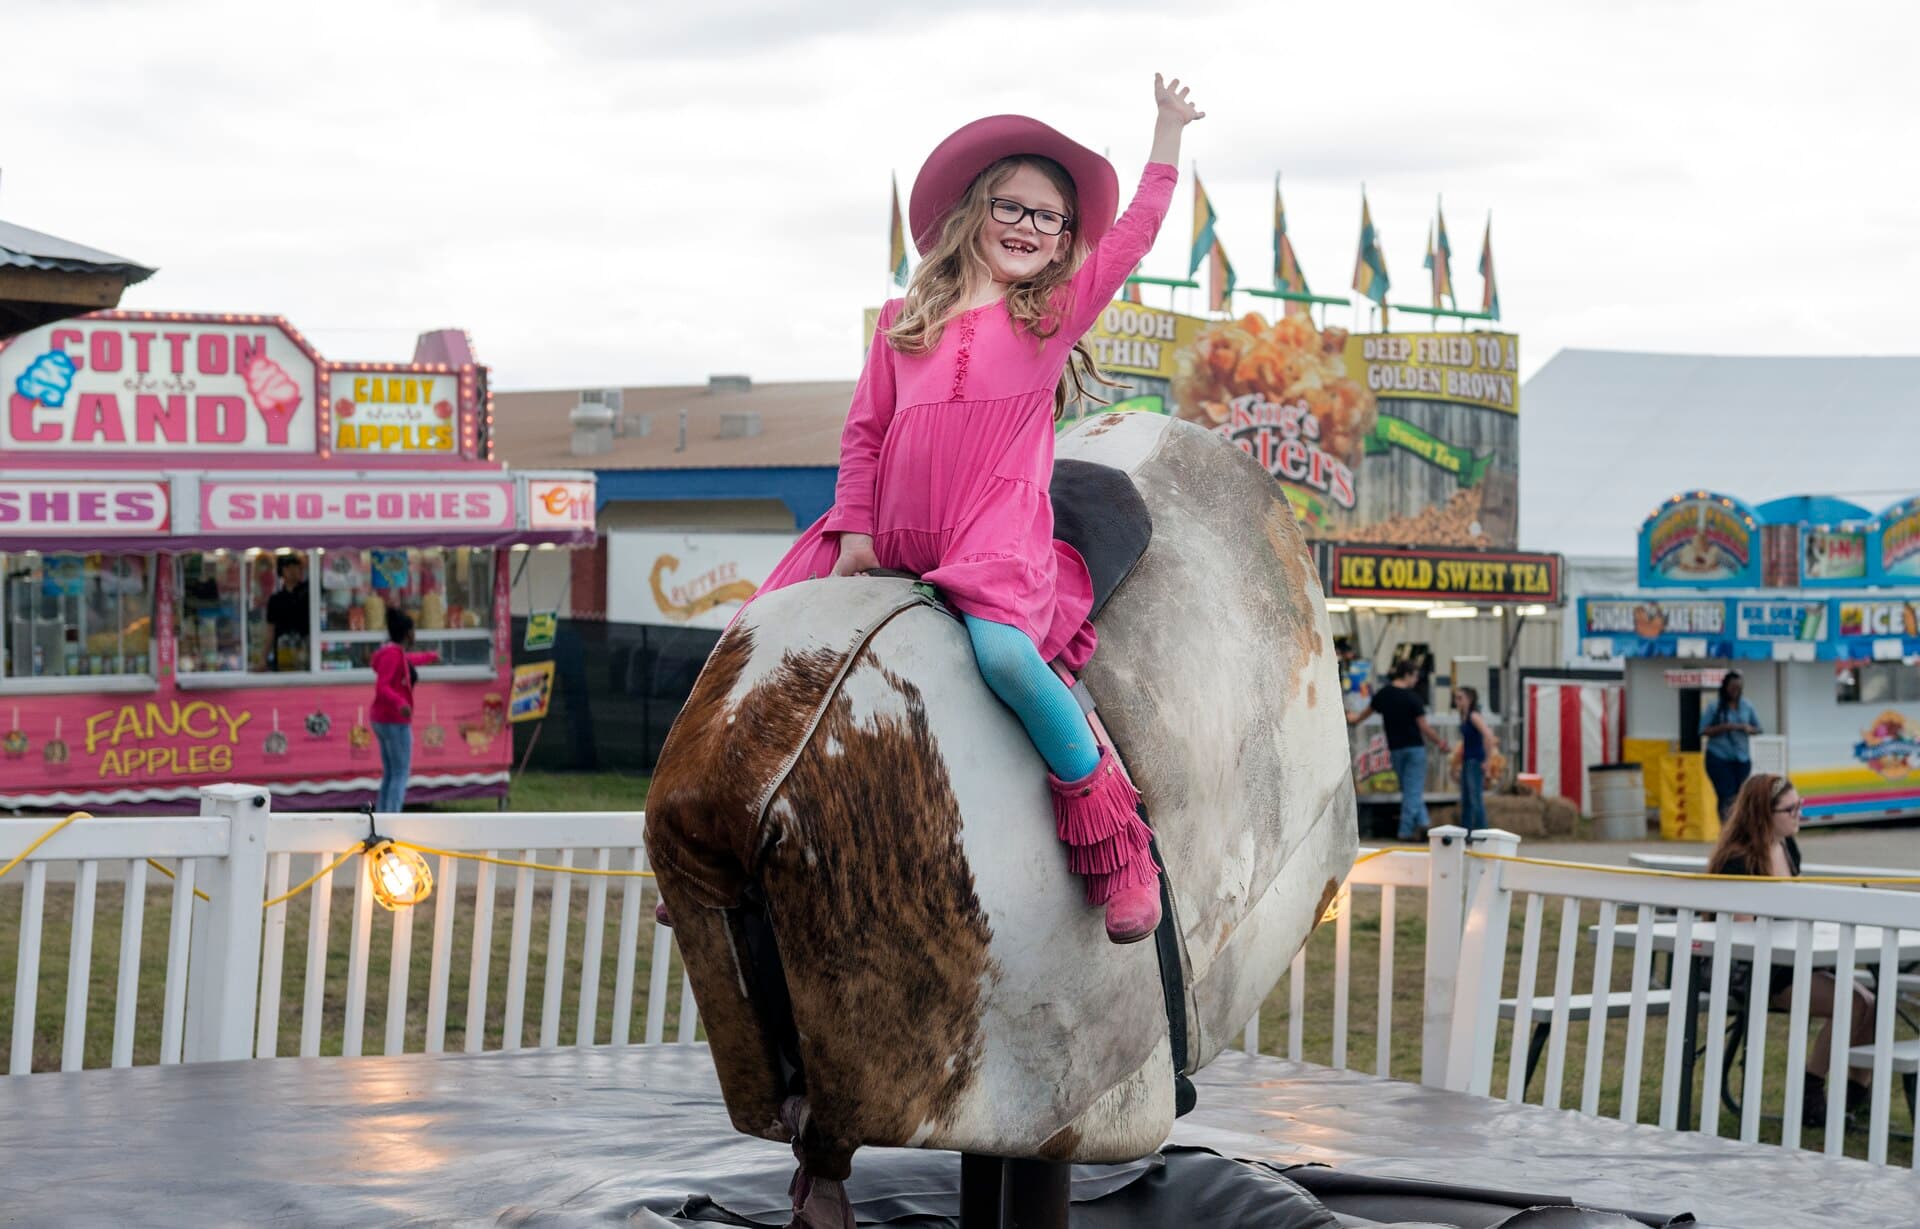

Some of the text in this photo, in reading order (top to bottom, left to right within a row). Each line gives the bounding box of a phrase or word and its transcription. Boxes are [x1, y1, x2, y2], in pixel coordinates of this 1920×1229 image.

[1103, 306, 1176, 340] OOOH
[50, 329, 266, 375] COTTON
[1096, 337, 1160, 369] THIN
[1363, 337, 1517, 370] DEEP FRIED TO A
[354, 378, 434, 404] CANDY
[1367, 365, 1513, 406] GOLDEN BROWN
[9, 392, 302, 445] CANDY
[1230, 392, 1320, 440] King's
[336, 422, 453, 450] APPLES
[1222, 424, 1356, 508] ters
[228, 492, 491, 520] SNO-CONES
[1341, 556, 1550, 594] ICE COLD SWEET TEA
[1862, 605, 1904, 636] ICE
[85, 700, 251, 754] FANCY
[99, 744, 233, 778] APPLES
